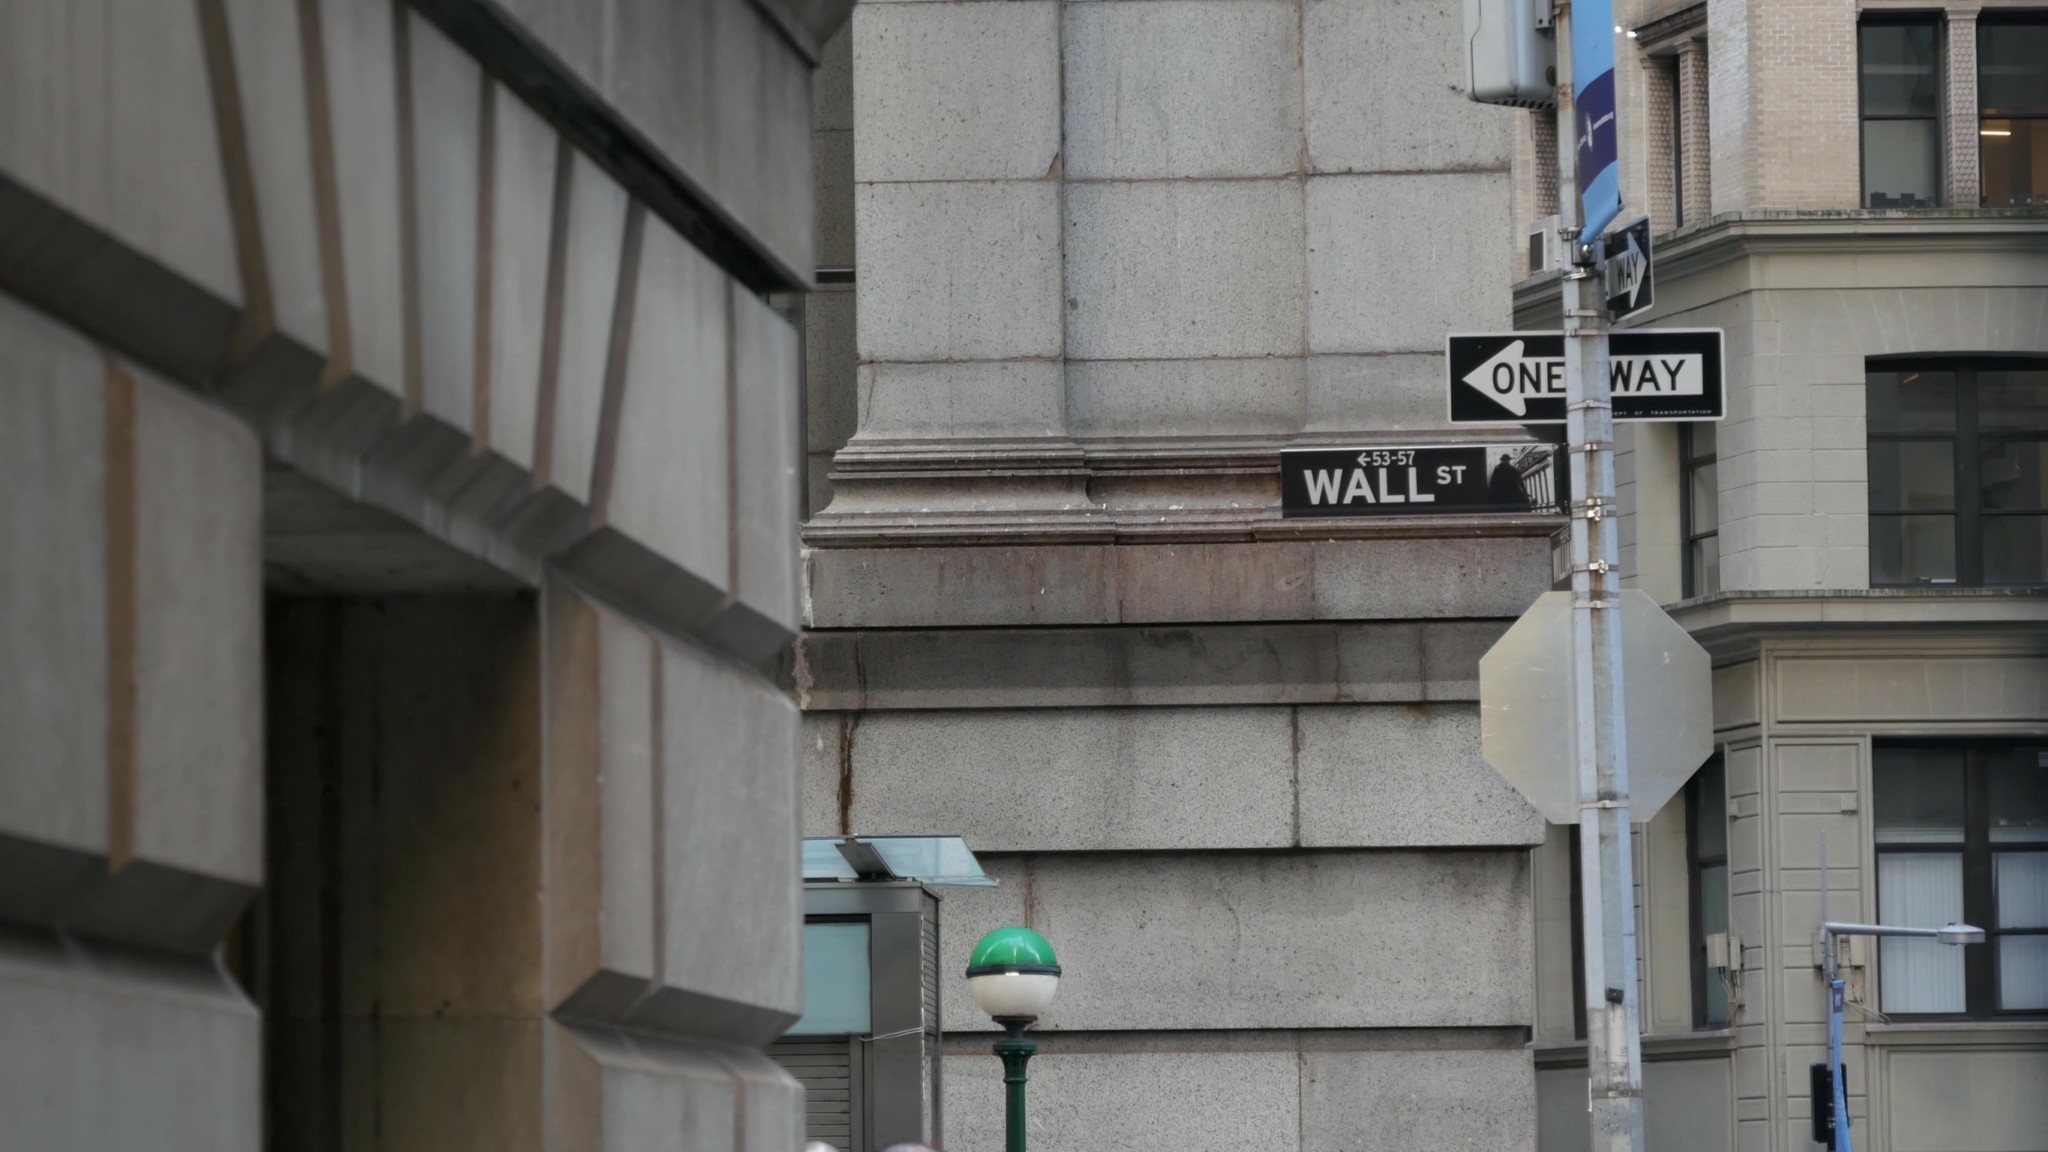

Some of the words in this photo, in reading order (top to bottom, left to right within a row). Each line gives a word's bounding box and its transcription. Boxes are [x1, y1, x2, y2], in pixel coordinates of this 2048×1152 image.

[1616, 251, 1640, 293] WAY
[1492, 361, 1566, 394] ONE
[1609, 359, 1686, 392] WAY
[1372, 451, 1415, 466] 53-57
[1303, 467, 1435, 505] WALL
[1437, 465, 1467, 485] ST
